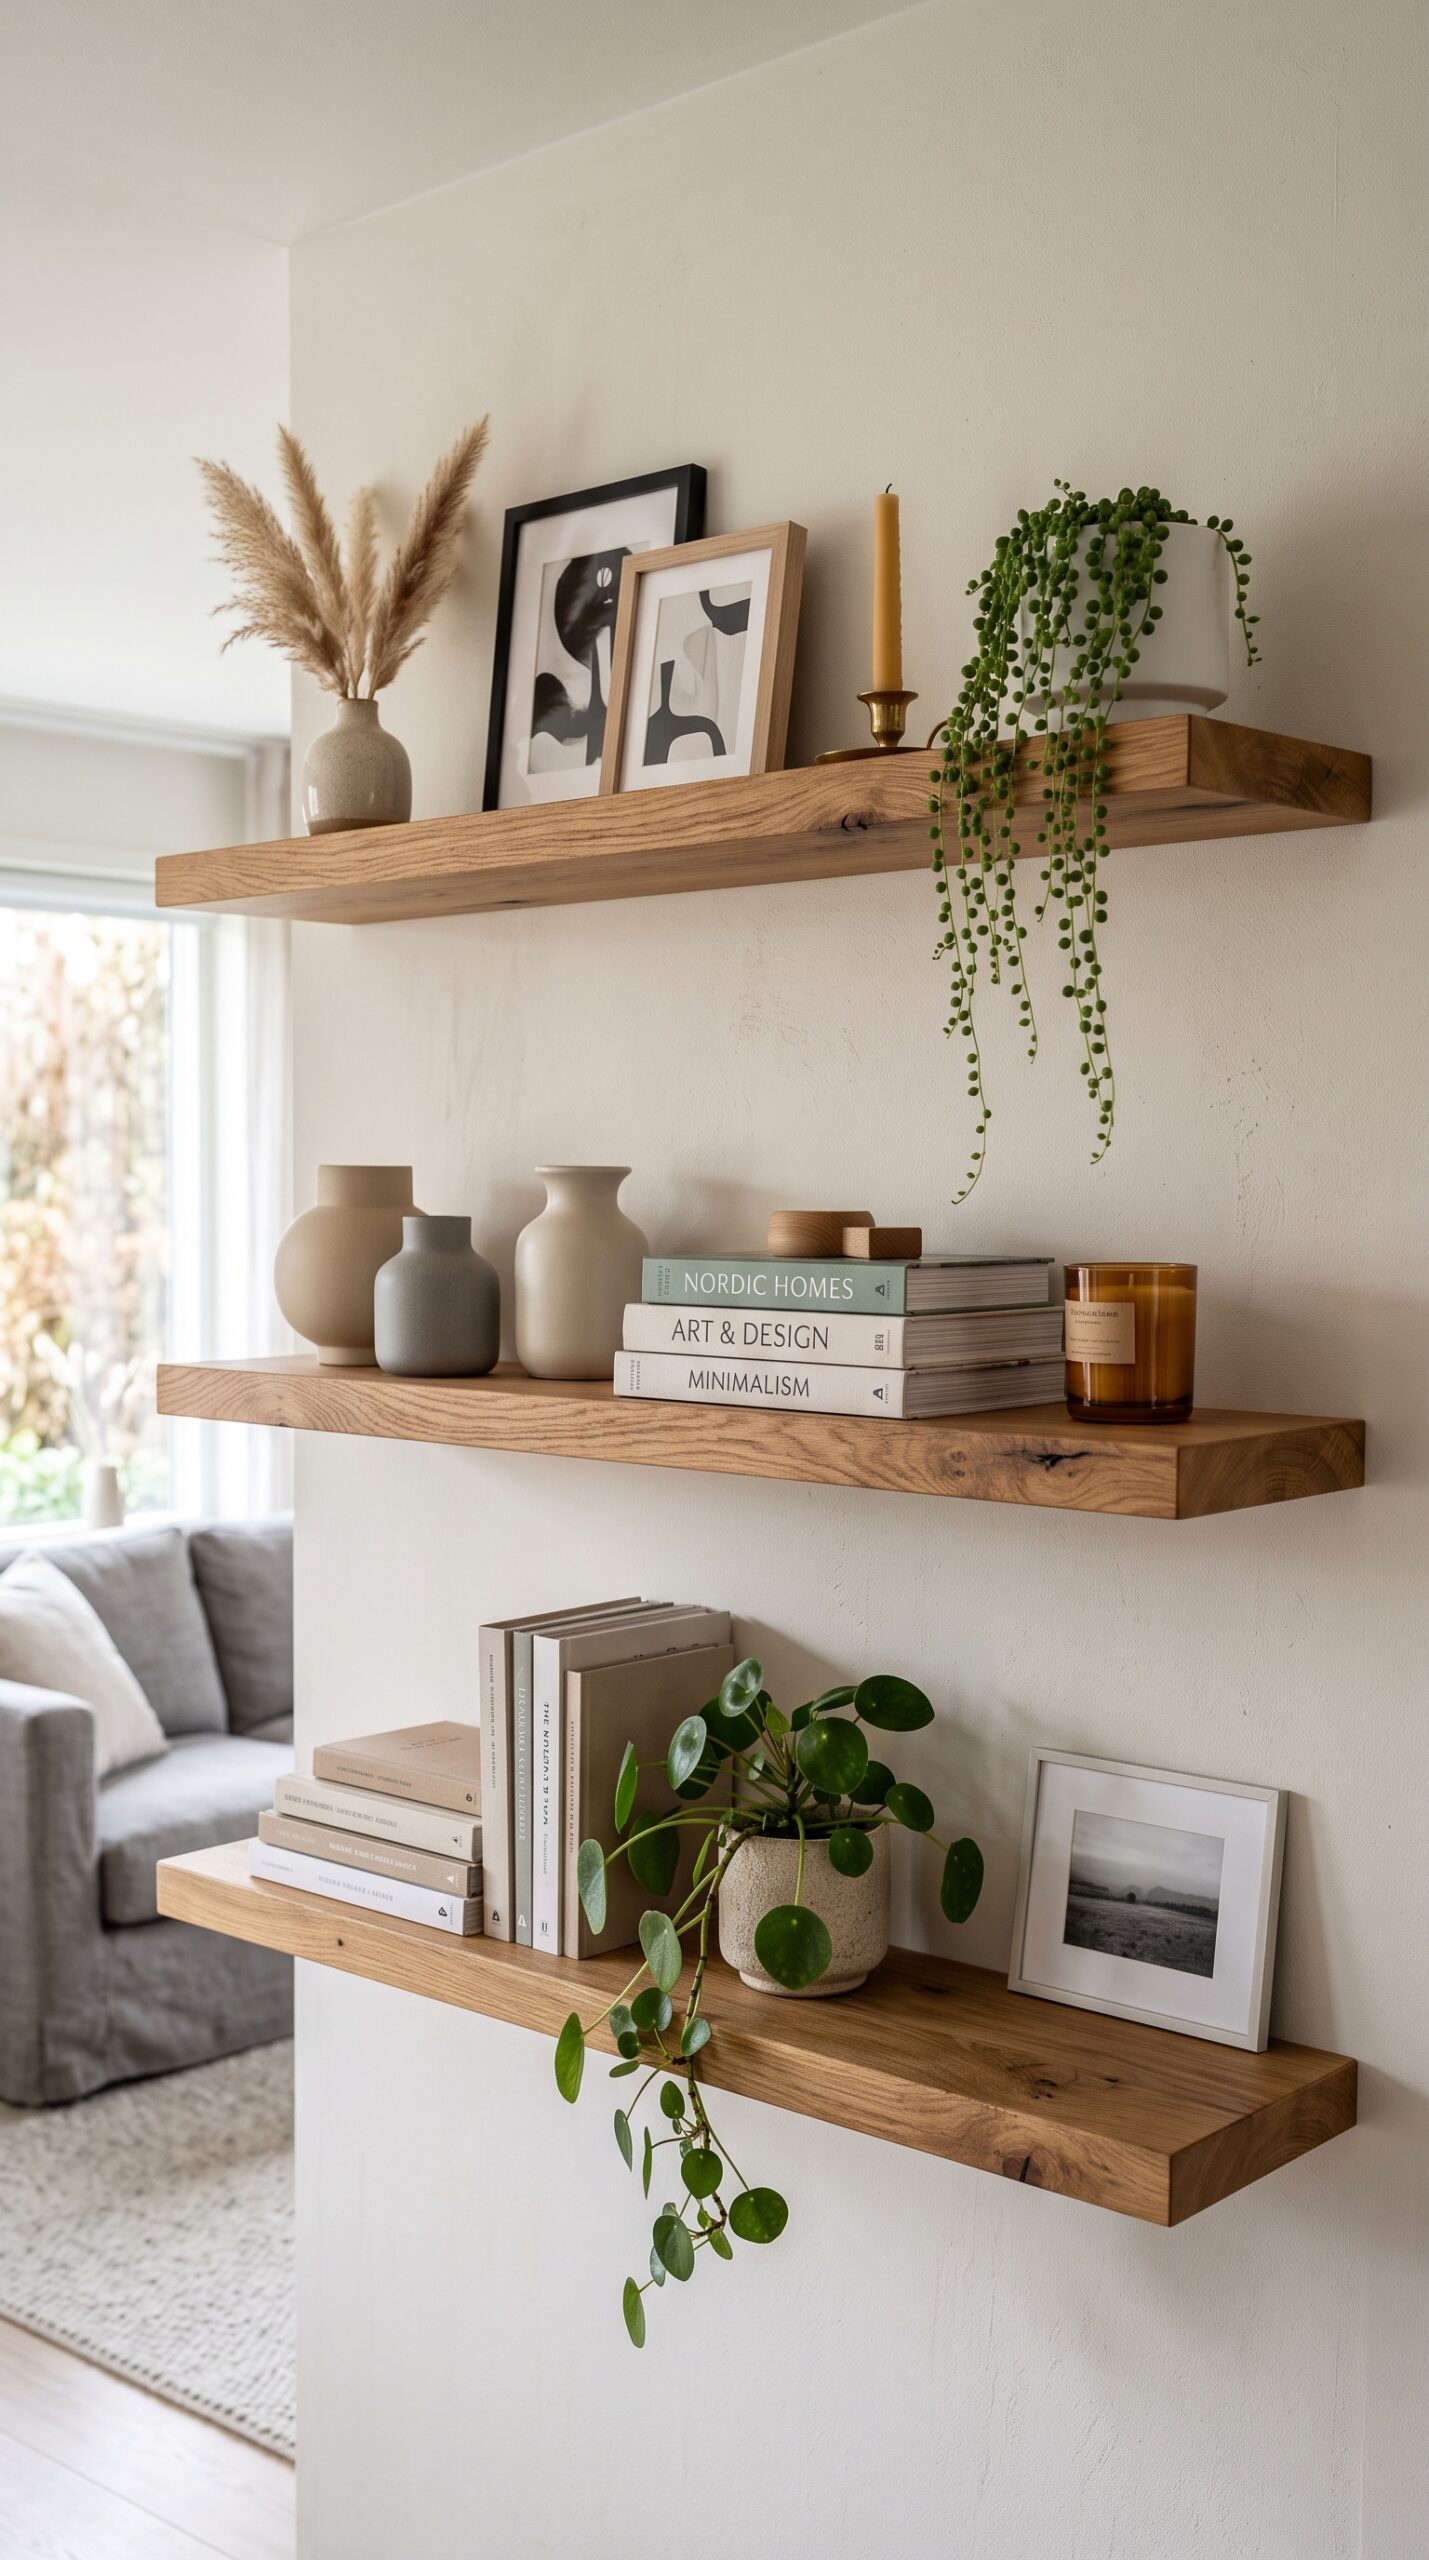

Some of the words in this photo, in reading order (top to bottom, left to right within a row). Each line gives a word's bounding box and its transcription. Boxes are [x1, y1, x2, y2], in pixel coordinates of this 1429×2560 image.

[684, 1272, 767, 1297] NORDIC
[775, 1275, 854, 1300] HOMES
[671, 1318, 714, 1343] ART
[720, 1320, 736, 1345] &
[743, 1322, 829, 1350] DESIGN
[688, 1369, 810, 1397] MINIMALISM
